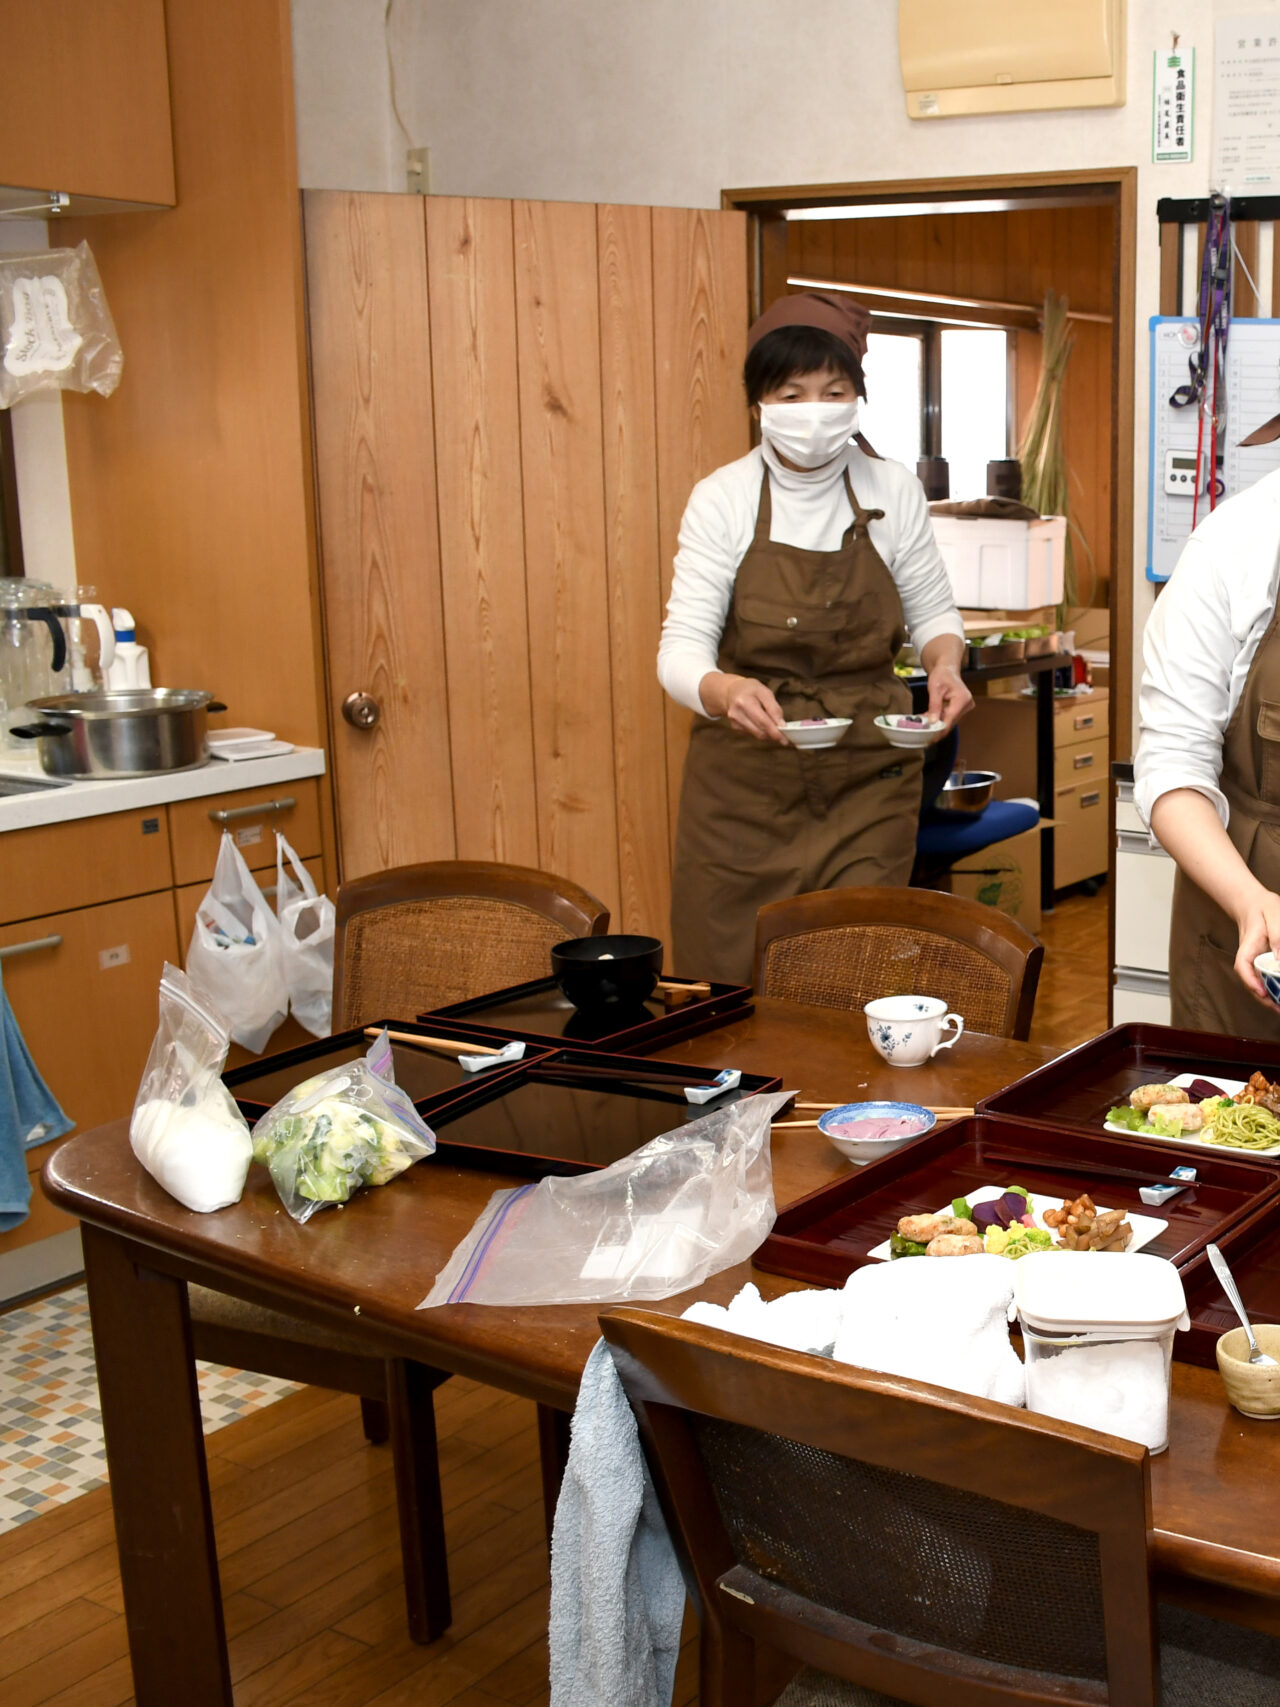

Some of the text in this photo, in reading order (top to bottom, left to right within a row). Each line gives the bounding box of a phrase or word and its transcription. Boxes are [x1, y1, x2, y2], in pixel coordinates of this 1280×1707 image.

[1175, 68, 1186, 147] 食品衛生責任者
